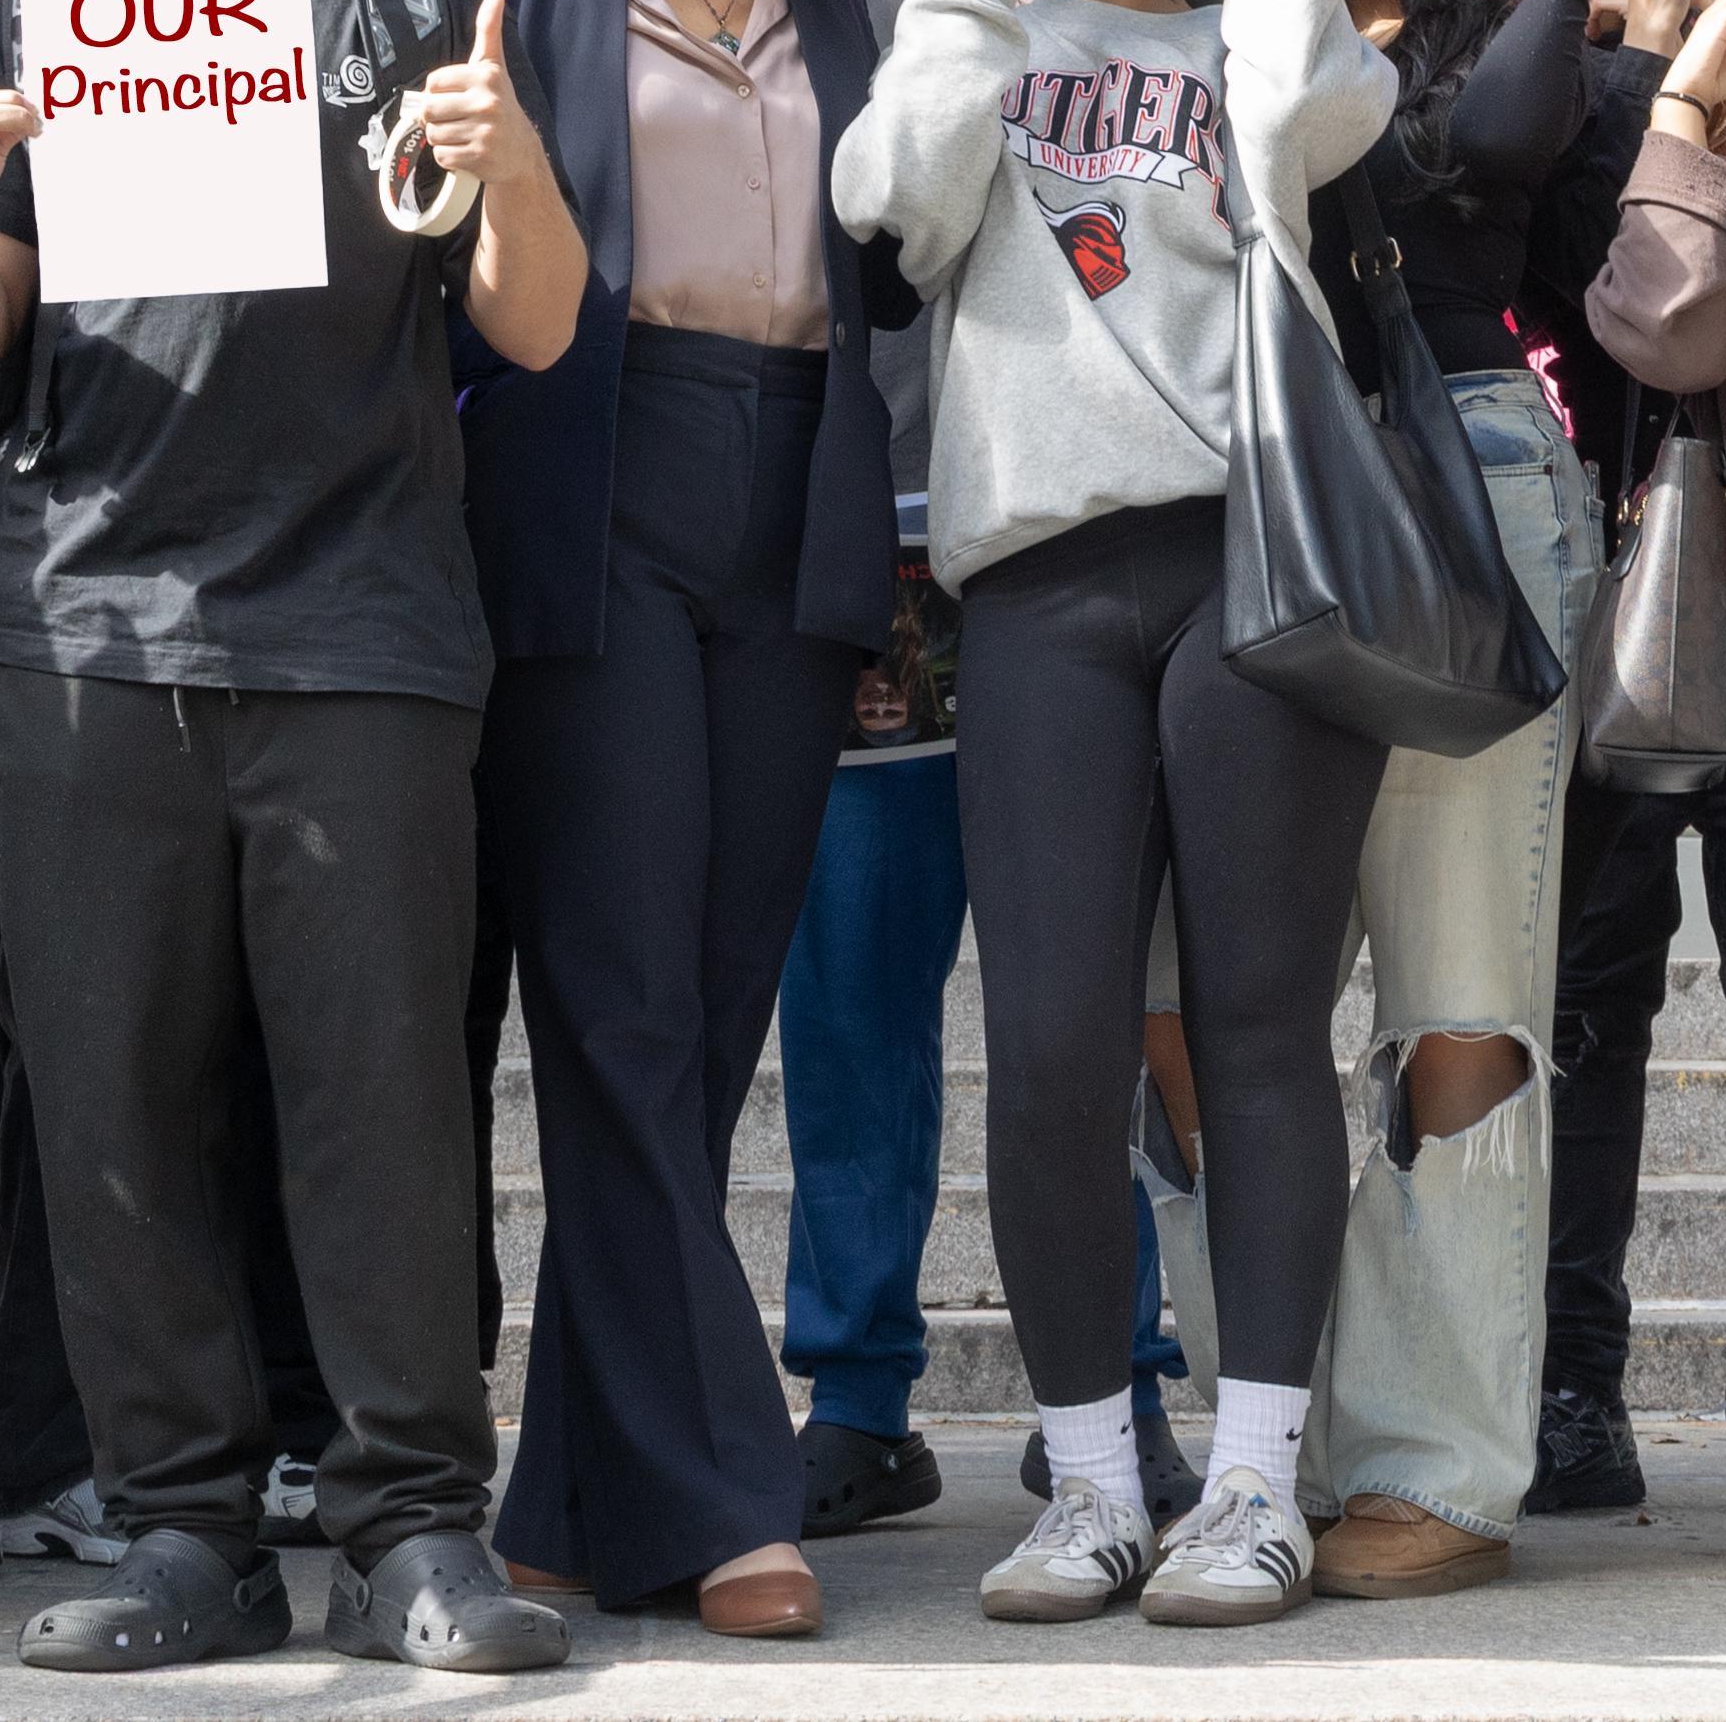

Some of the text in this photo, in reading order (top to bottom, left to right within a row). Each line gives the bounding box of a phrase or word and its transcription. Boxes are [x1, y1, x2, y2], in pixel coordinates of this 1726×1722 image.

[42, 47, 306, 125] Principal
[1000, 58, 1231, 234] UTGER
[1039, 142, 1146, 180] UNIVERSITY
